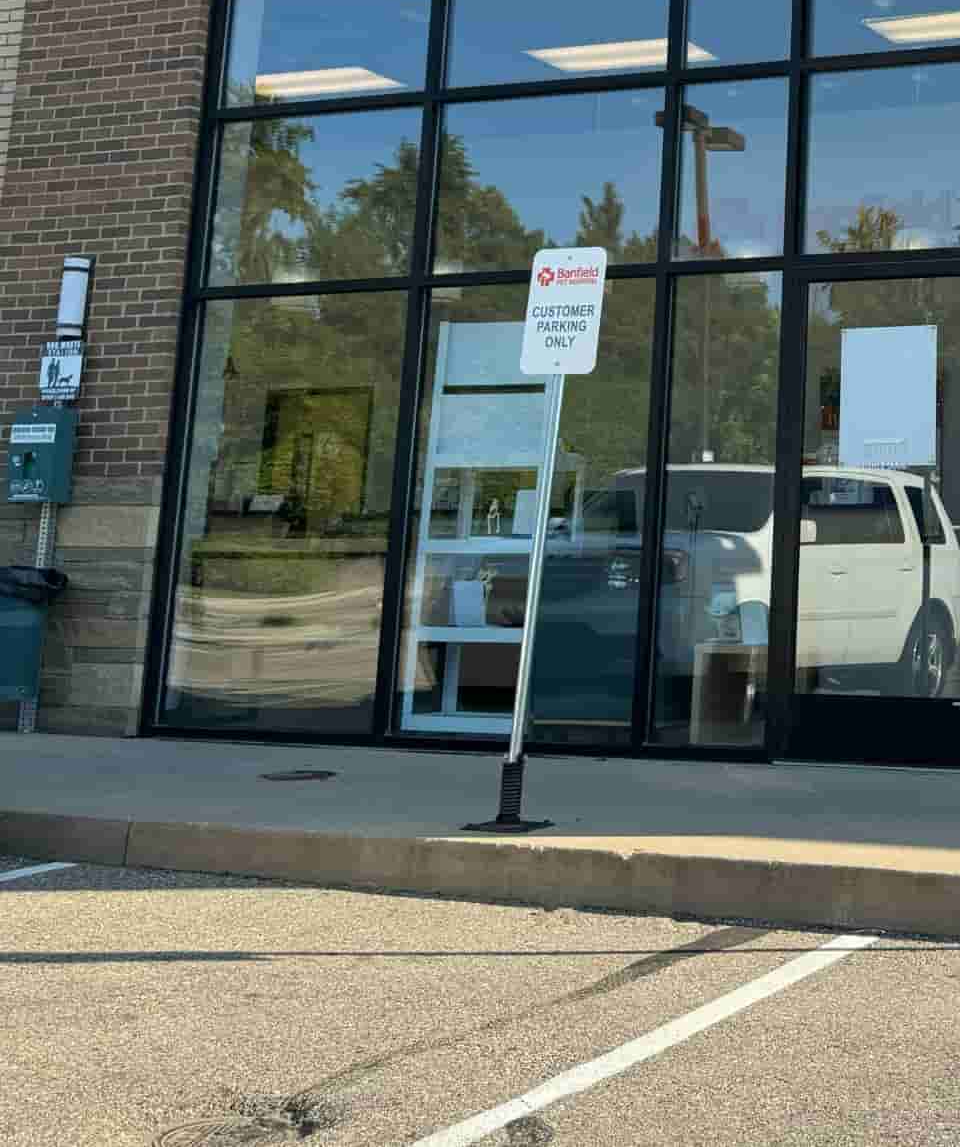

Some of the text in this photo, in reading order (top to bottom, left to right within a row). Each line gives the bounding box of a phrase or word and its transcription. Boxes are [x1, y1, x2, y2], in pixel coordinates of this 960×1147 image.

[556, 266, 599, 279] Banfield
[532, 304, 595, 318] CUSTOMER
[536, 320, 587, 333] PARKING
[544, 335, 576, 349] ONLY
